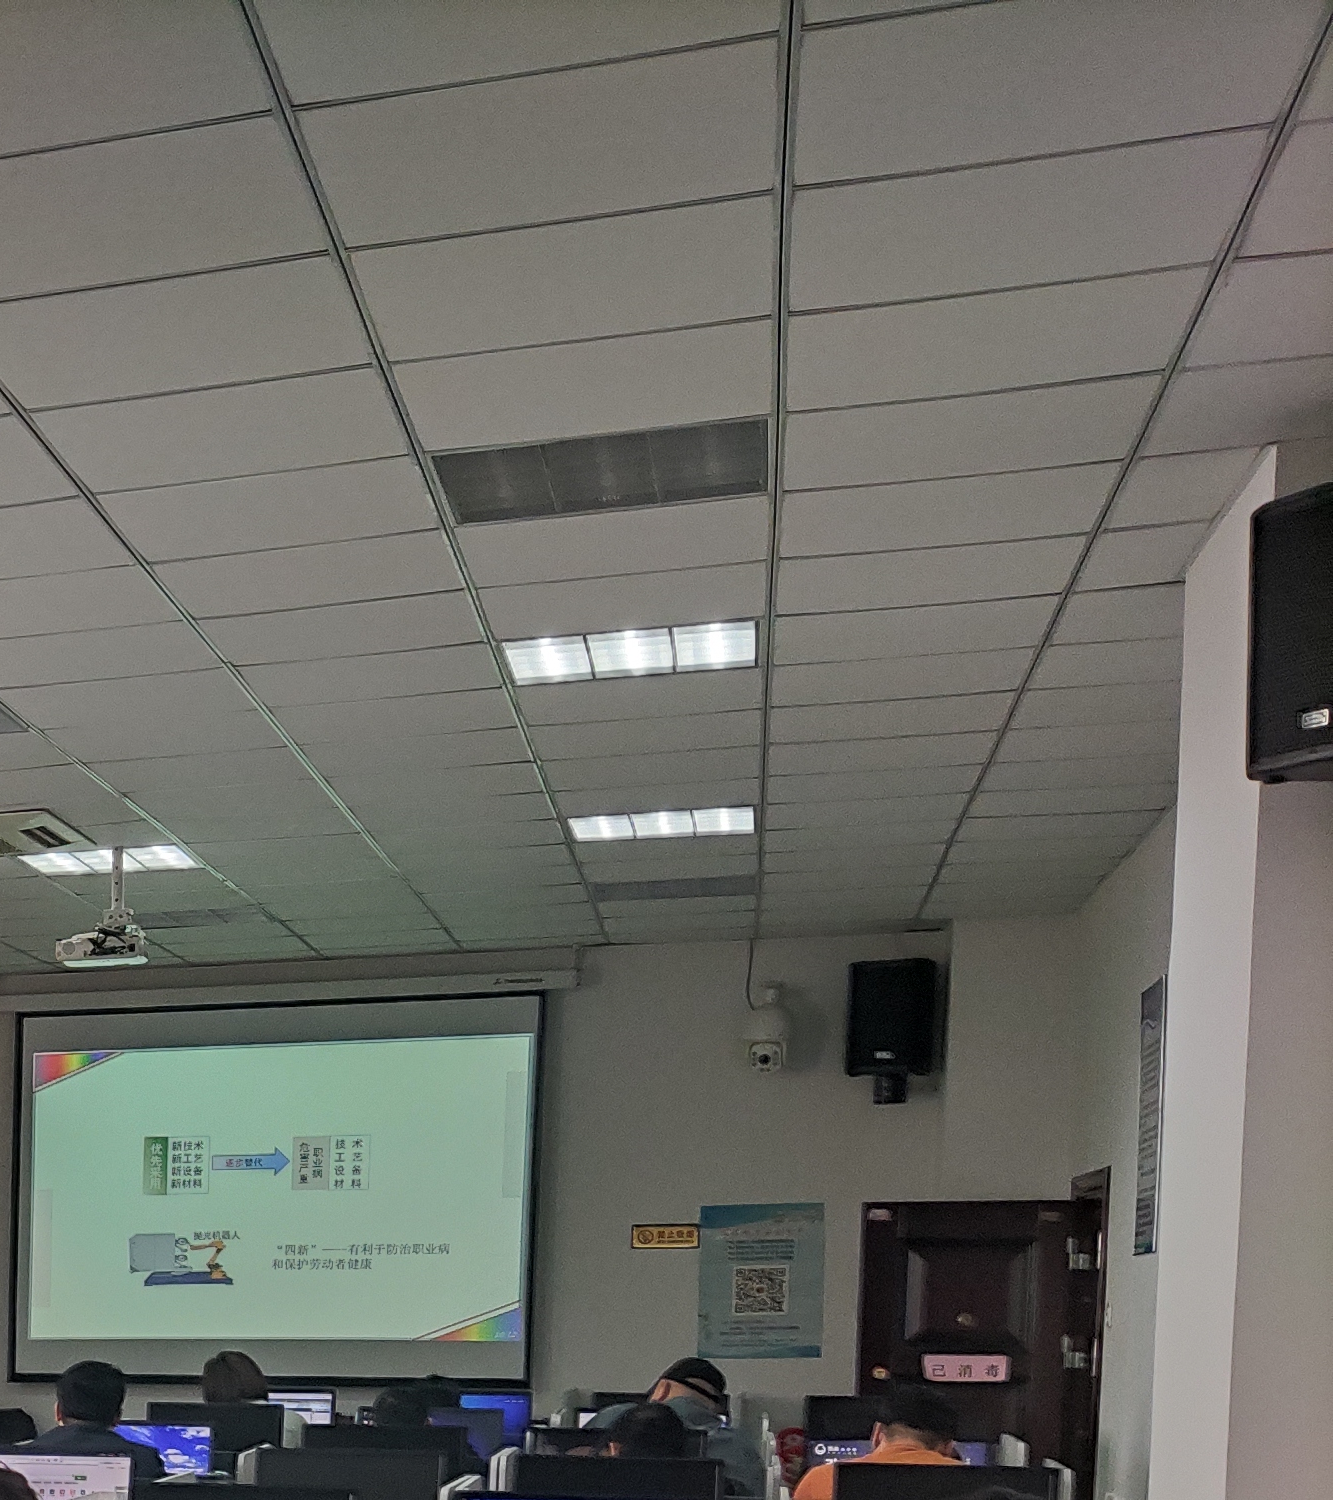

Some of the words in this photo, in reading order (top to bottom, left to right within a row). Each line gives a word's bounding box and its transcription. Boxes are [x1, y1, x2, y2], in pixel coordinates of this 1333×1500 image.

[172, 1140, 204, 1151] 新技术
[171, 1153, 203, 1164] 新工艺
[312, 1147, 324, 1179] 职业病
[171, 1165, 203, 1176] 新设备
[170, 1178, 202, 1189] 新材料
[271, 1258, 373, 1270] 和保护劳动者健康
